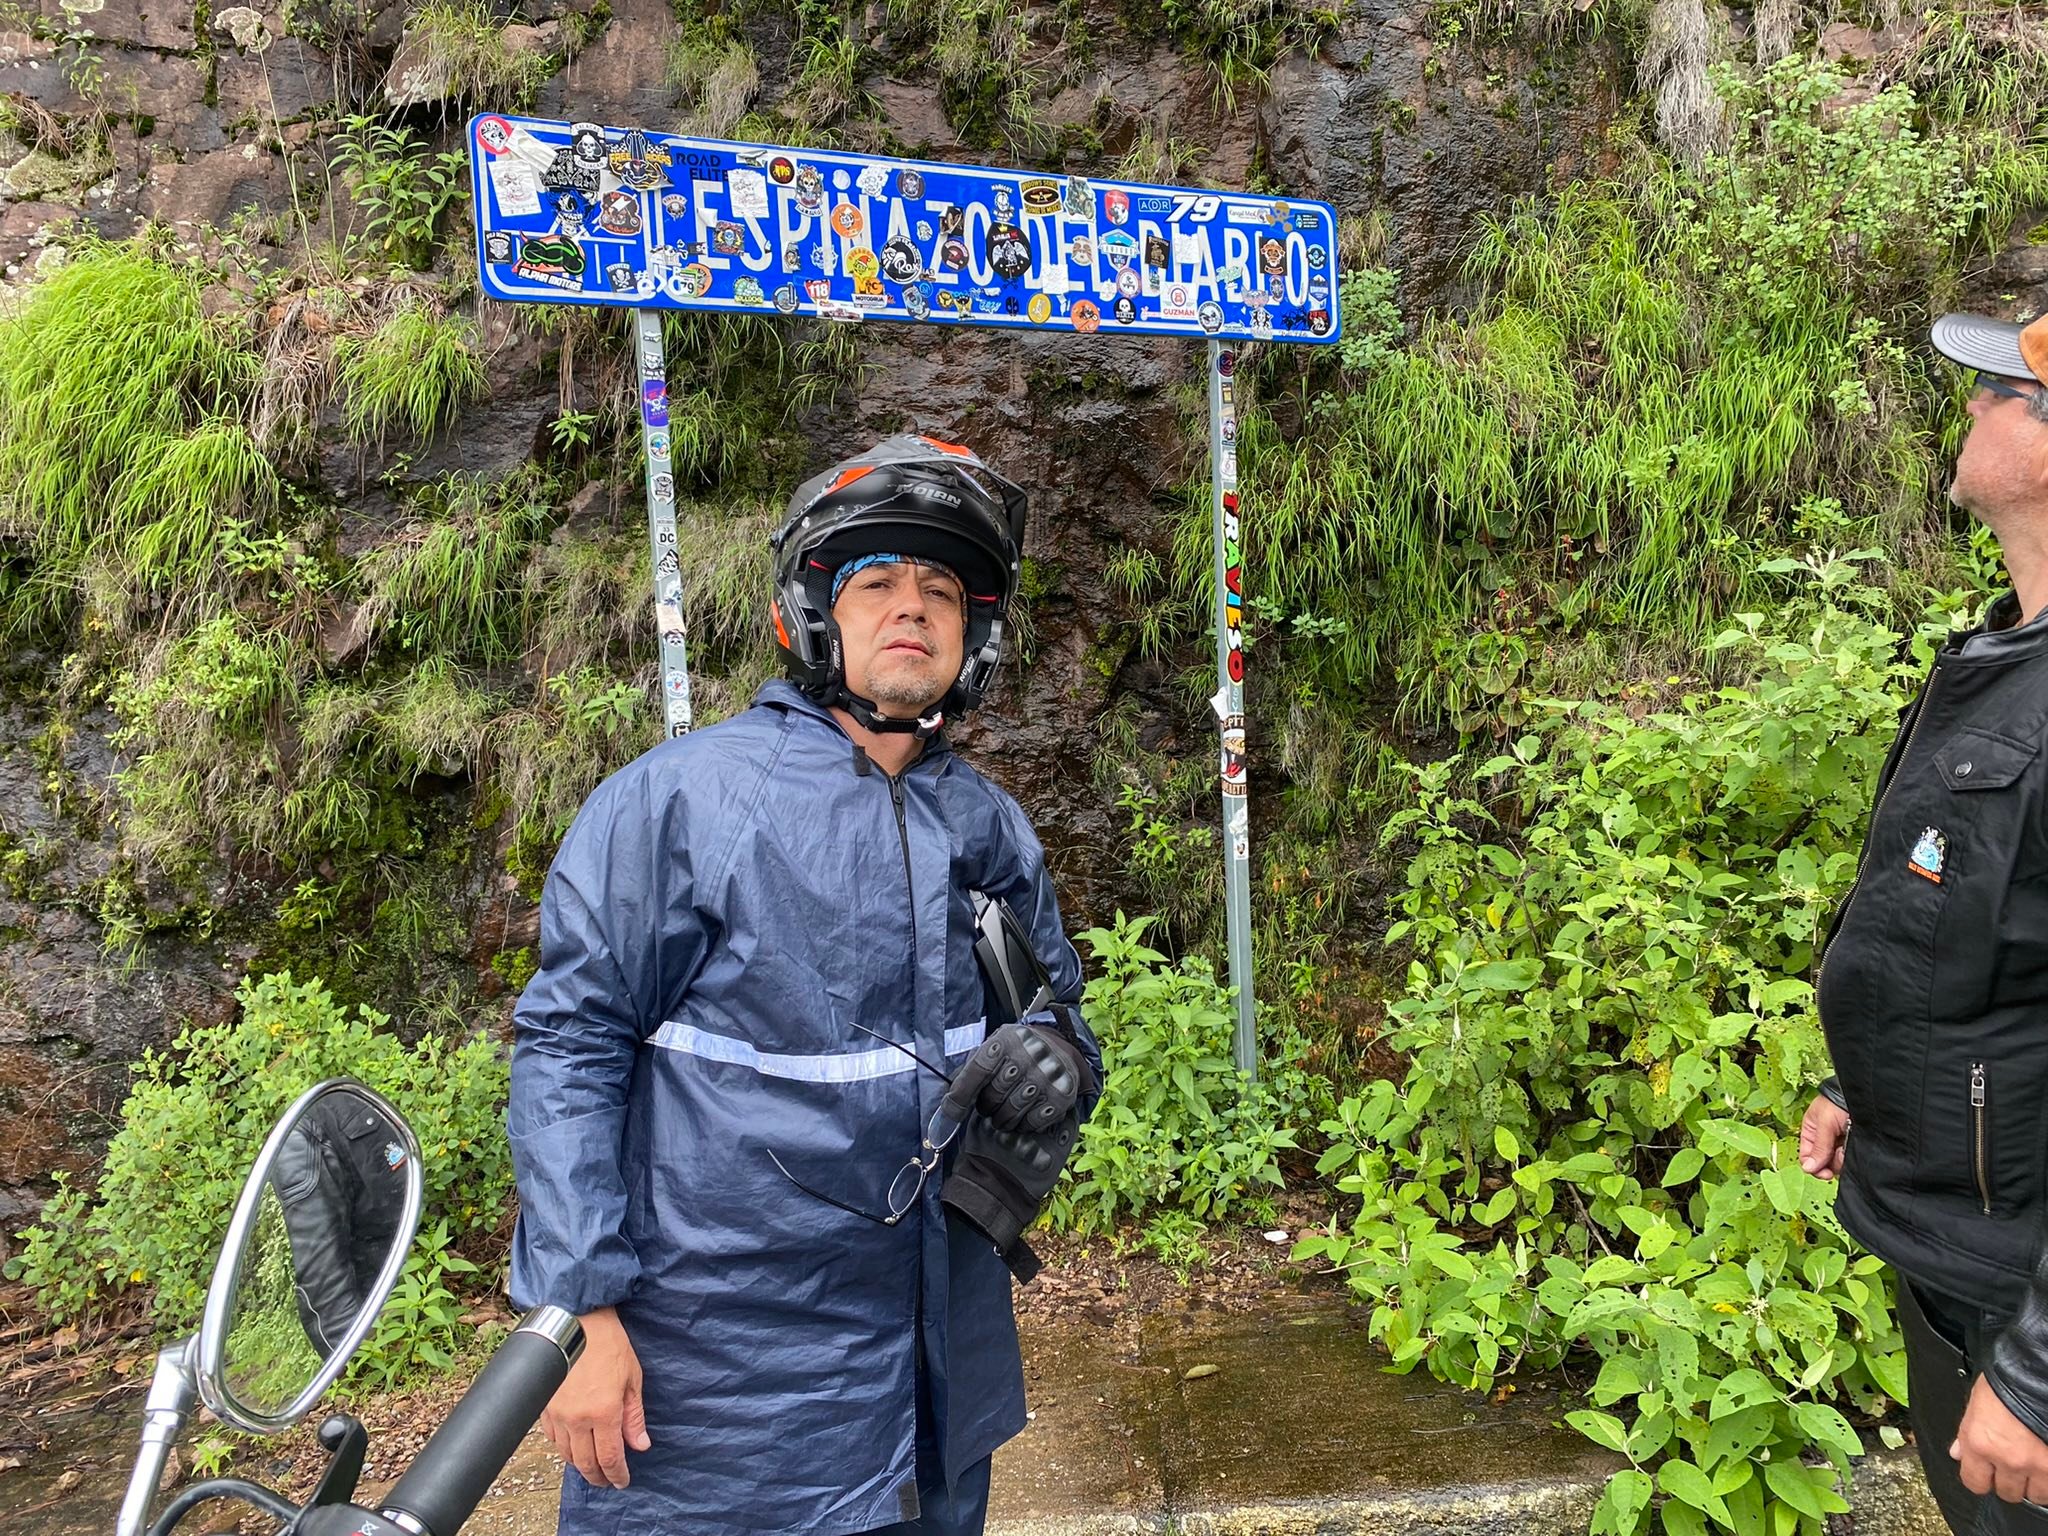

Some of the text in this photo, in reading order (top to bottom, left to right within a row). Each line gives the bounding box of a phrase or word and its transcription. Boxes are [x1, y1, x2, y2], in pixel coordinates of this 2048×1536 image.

[676, 152, 721, 167] ROAD
[1166, 195, 1222, 223] 79
[518, 267, 582, 292] ALPHA MOTORS
[680, 281, 695, 295] 79
[808, 283, 829, 298] 118
[1163, 308, 1196, 317] GUZMÁN
[896, 482, 962, 507] NOLAN
[659, 533, 675, 544] DC
[1223, 491, 1245, 683] TRAVIESO
